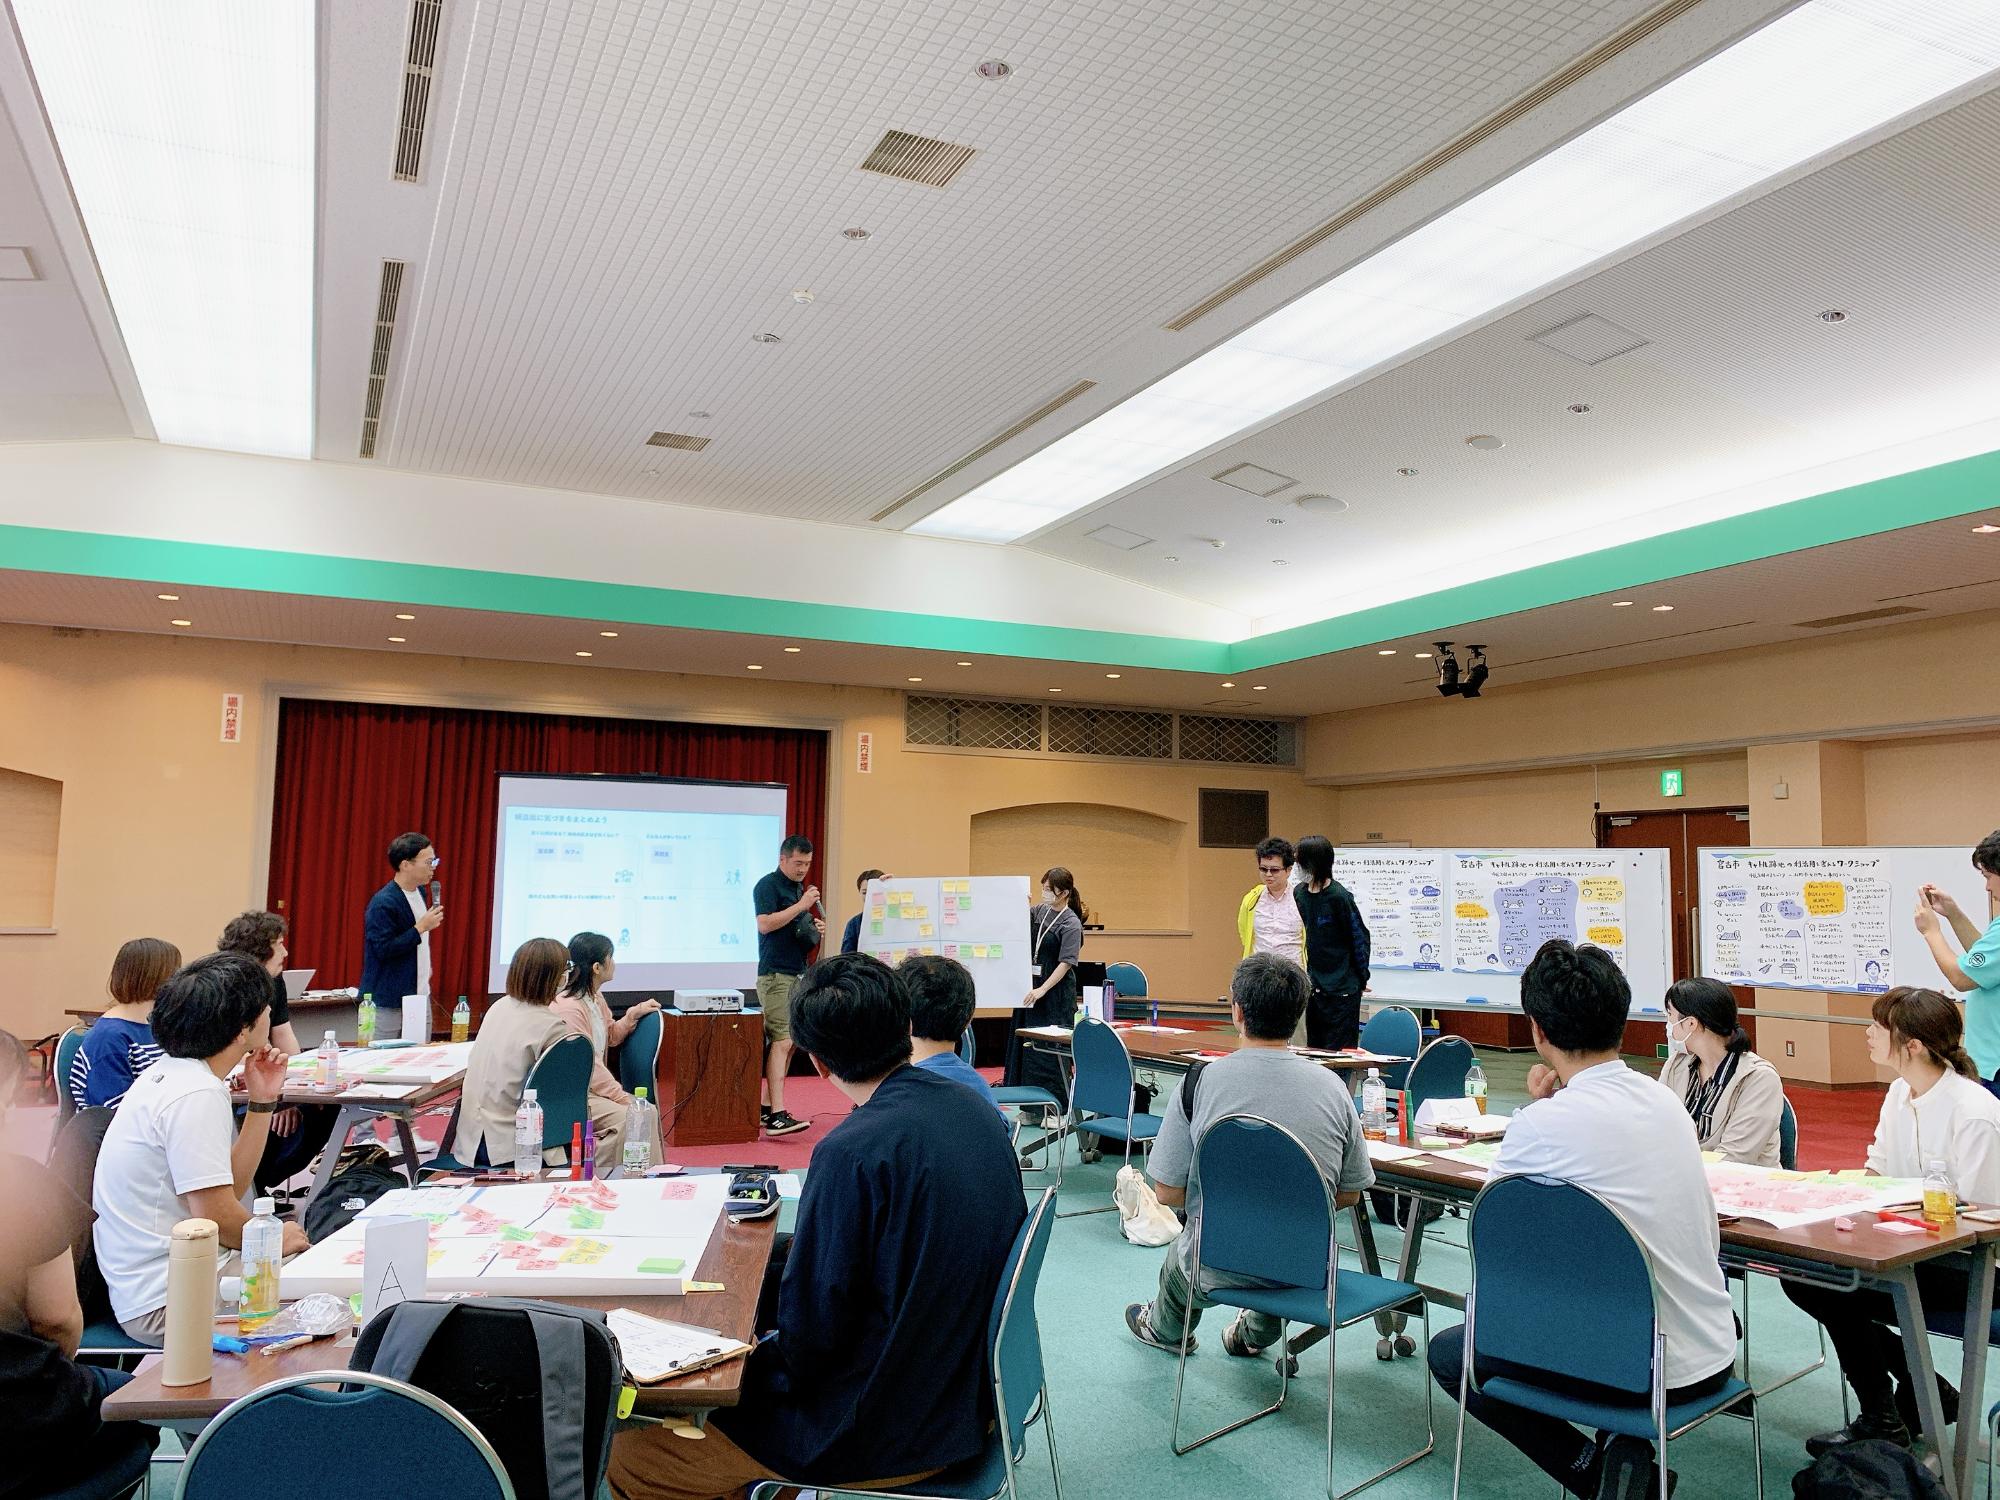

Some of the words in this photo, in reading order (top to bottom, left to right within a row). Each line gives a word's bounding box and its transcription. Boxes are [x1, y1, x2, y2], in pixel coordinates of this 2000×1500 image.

[1717, 859, 1740, 870] 宮古市
[375, 1260, 407, 1311] A
